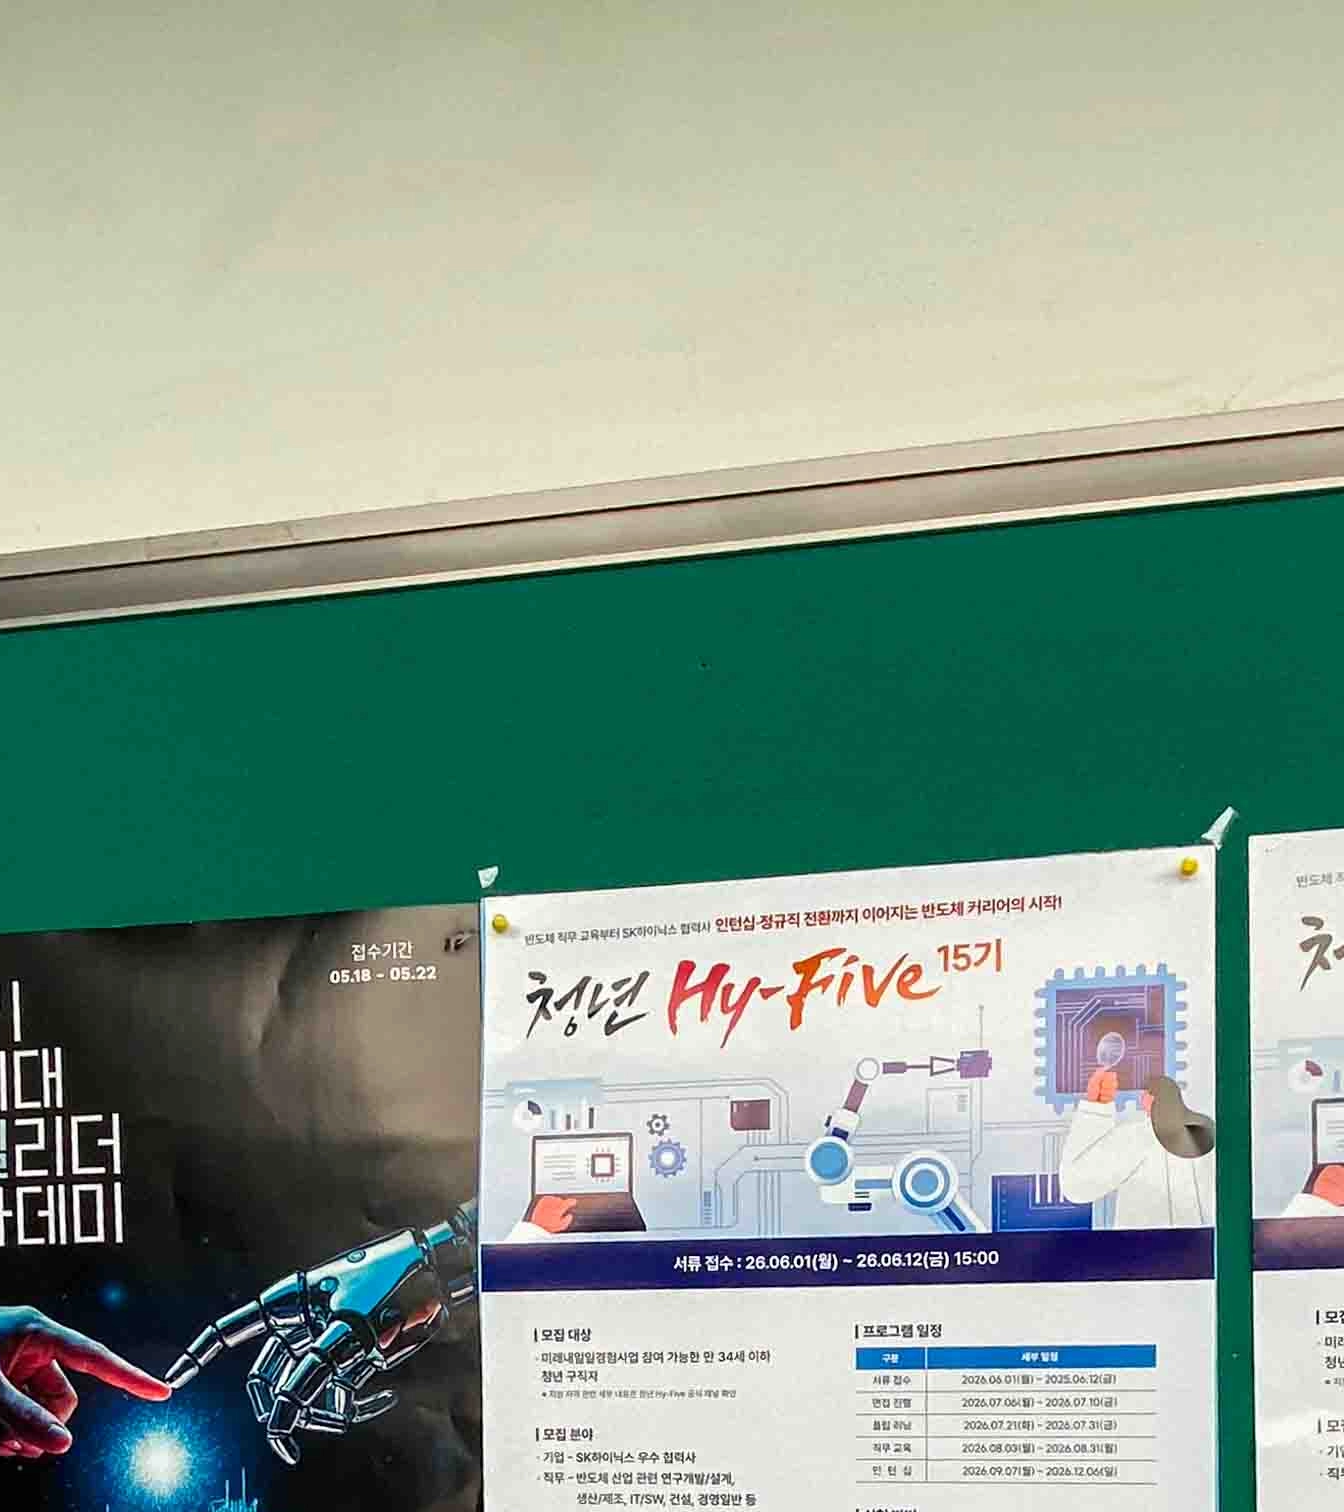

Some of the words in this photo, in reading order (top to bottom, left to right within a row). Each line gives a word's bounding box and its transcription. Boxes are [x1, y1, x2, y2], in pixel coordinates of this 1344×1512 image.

[622, 924, 677, 938] SK하이닉스
[804, 909, 858, 926] 전환까지
[862, 905, 918, 923] 이어지는
[922, 901, 964, 919] 반도체
[968, 897, 1024, 915] 커리어의
[1029, 895, 1062, 911] 시작!
[351, 942, 413, 962] 접수기간
[330, 968, 371, 984] 05.18
[390, 966, 436, 981] 05.22
[526, 971, 650, 1039] 청년
[668, 947, 944, 1048] Hy-Five
[937, 938, 1001, 972] 15기
[674, 1256, 701, 1272] 서류
[705, 1255, 733, 1270] 접수
[745, 1254, 838, 1270] 26.06.01(월)
[857, 1252, 949, 1269] 26.06.12(금)
[954, 1251, 999, 1265] 15:00
[542, 1328, 564, 1342] 모집
[568, 1328, 592, 1342] 대상
[863, 1325, 913, 1338] 프로그램
[917, 1324, 942, 1338] 일정
[543, 1428, 566, 1441] 모집
[570, 1428, 593, 1441] 분야
